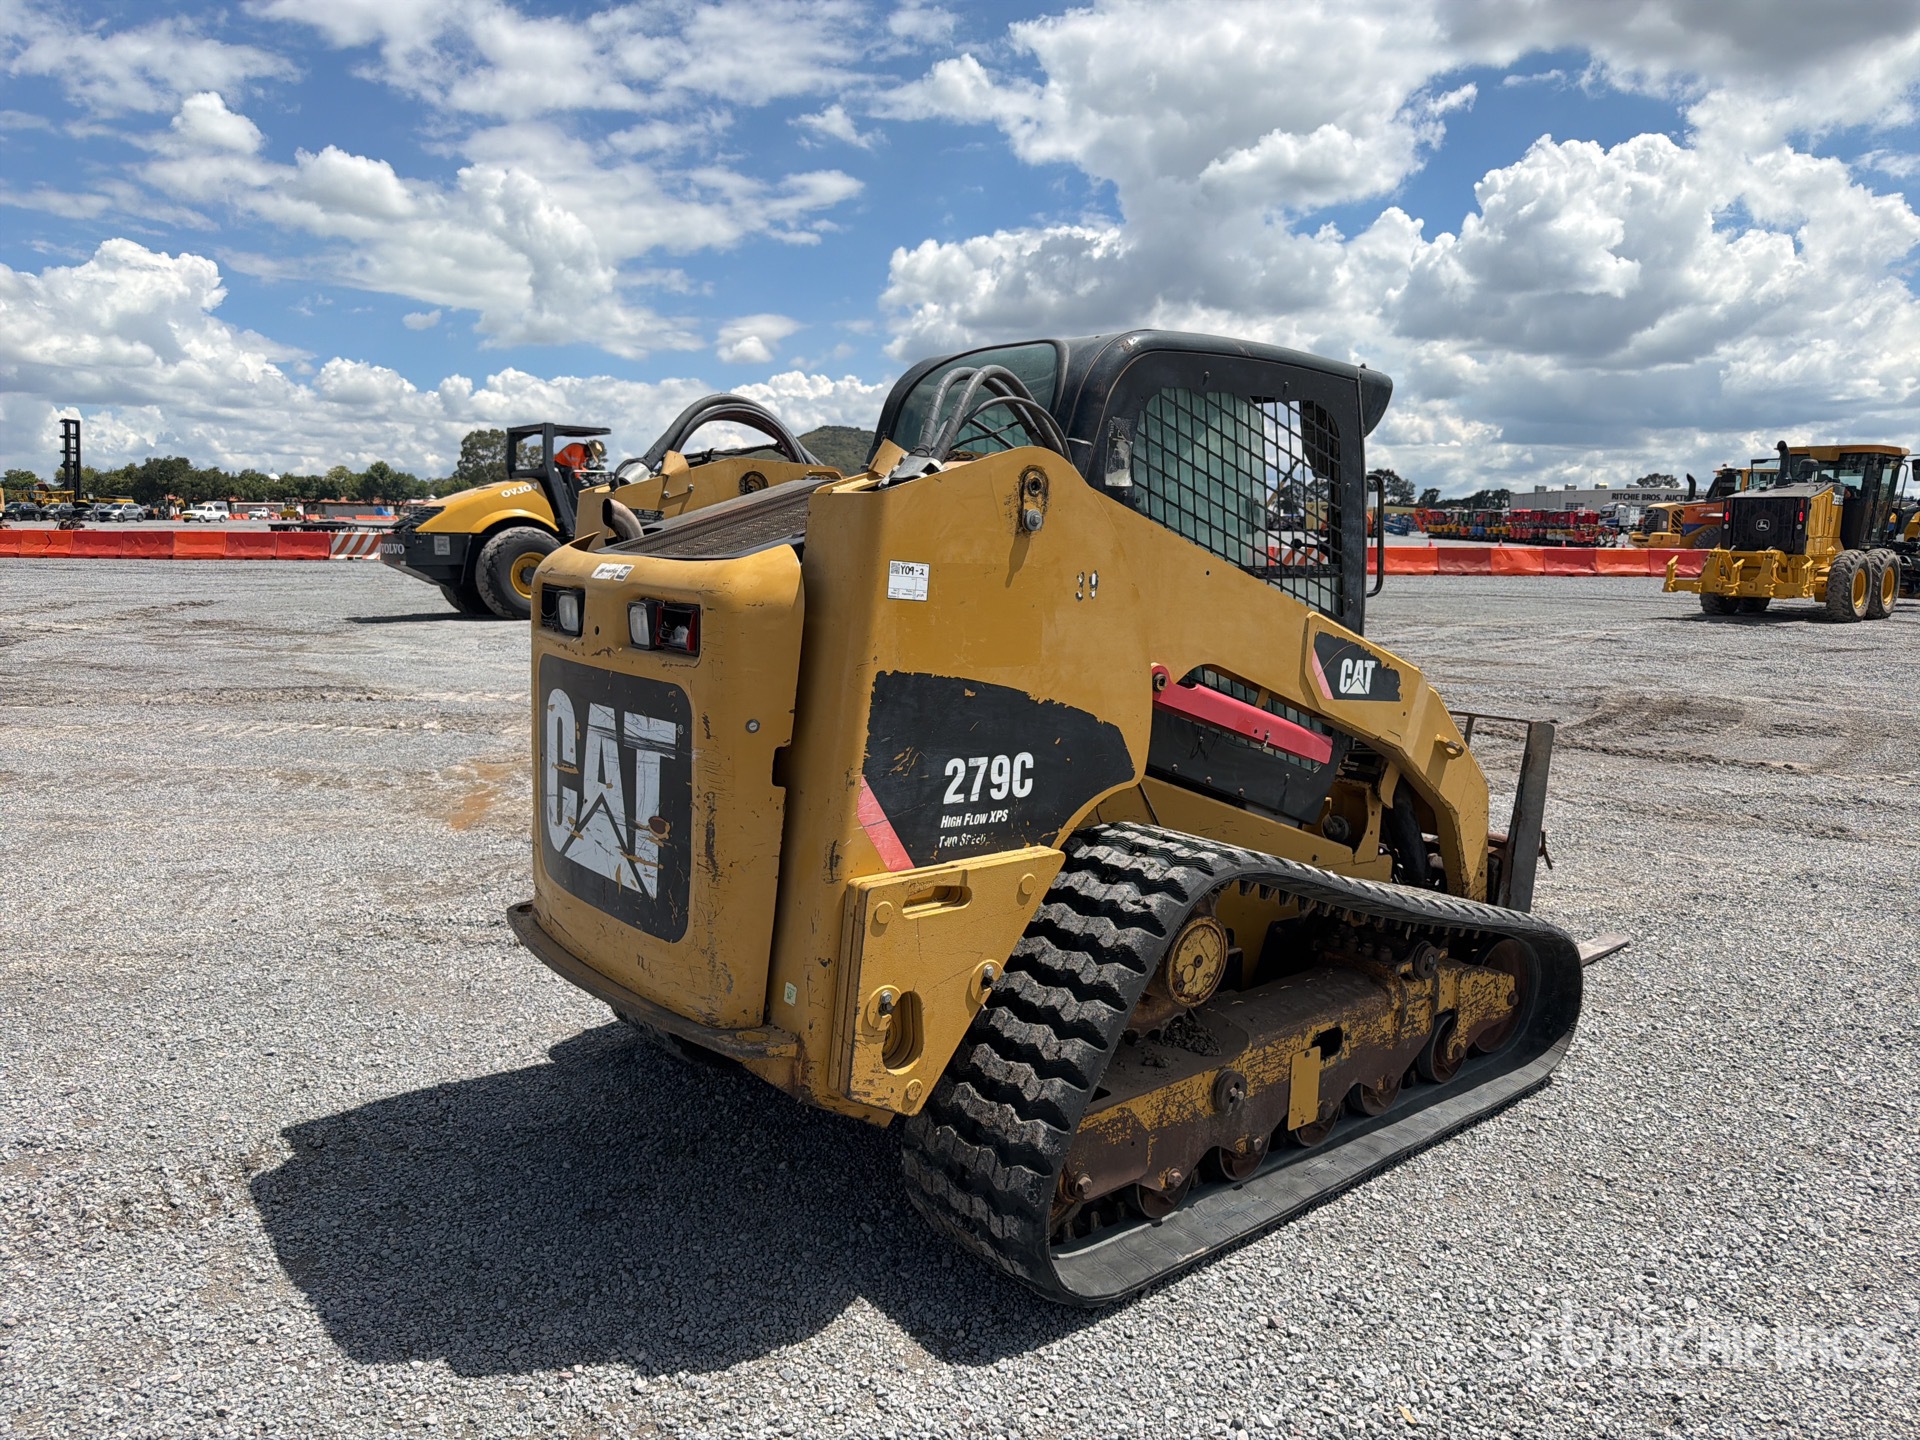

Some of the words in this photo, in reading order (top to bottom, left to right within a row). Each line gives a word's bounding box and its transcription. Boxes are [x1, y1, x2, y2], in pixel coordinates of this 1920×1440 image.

[1611, 492, 1640, 500] RITCHIE
[380, 543, 405, 555] VOLVO
[1339, 658, 1376, 695] CAT
[943, 752, 1034, 805] 279C
[546, 688, 677, 899] CAT
[989, 809, 1009, 824] XPS
